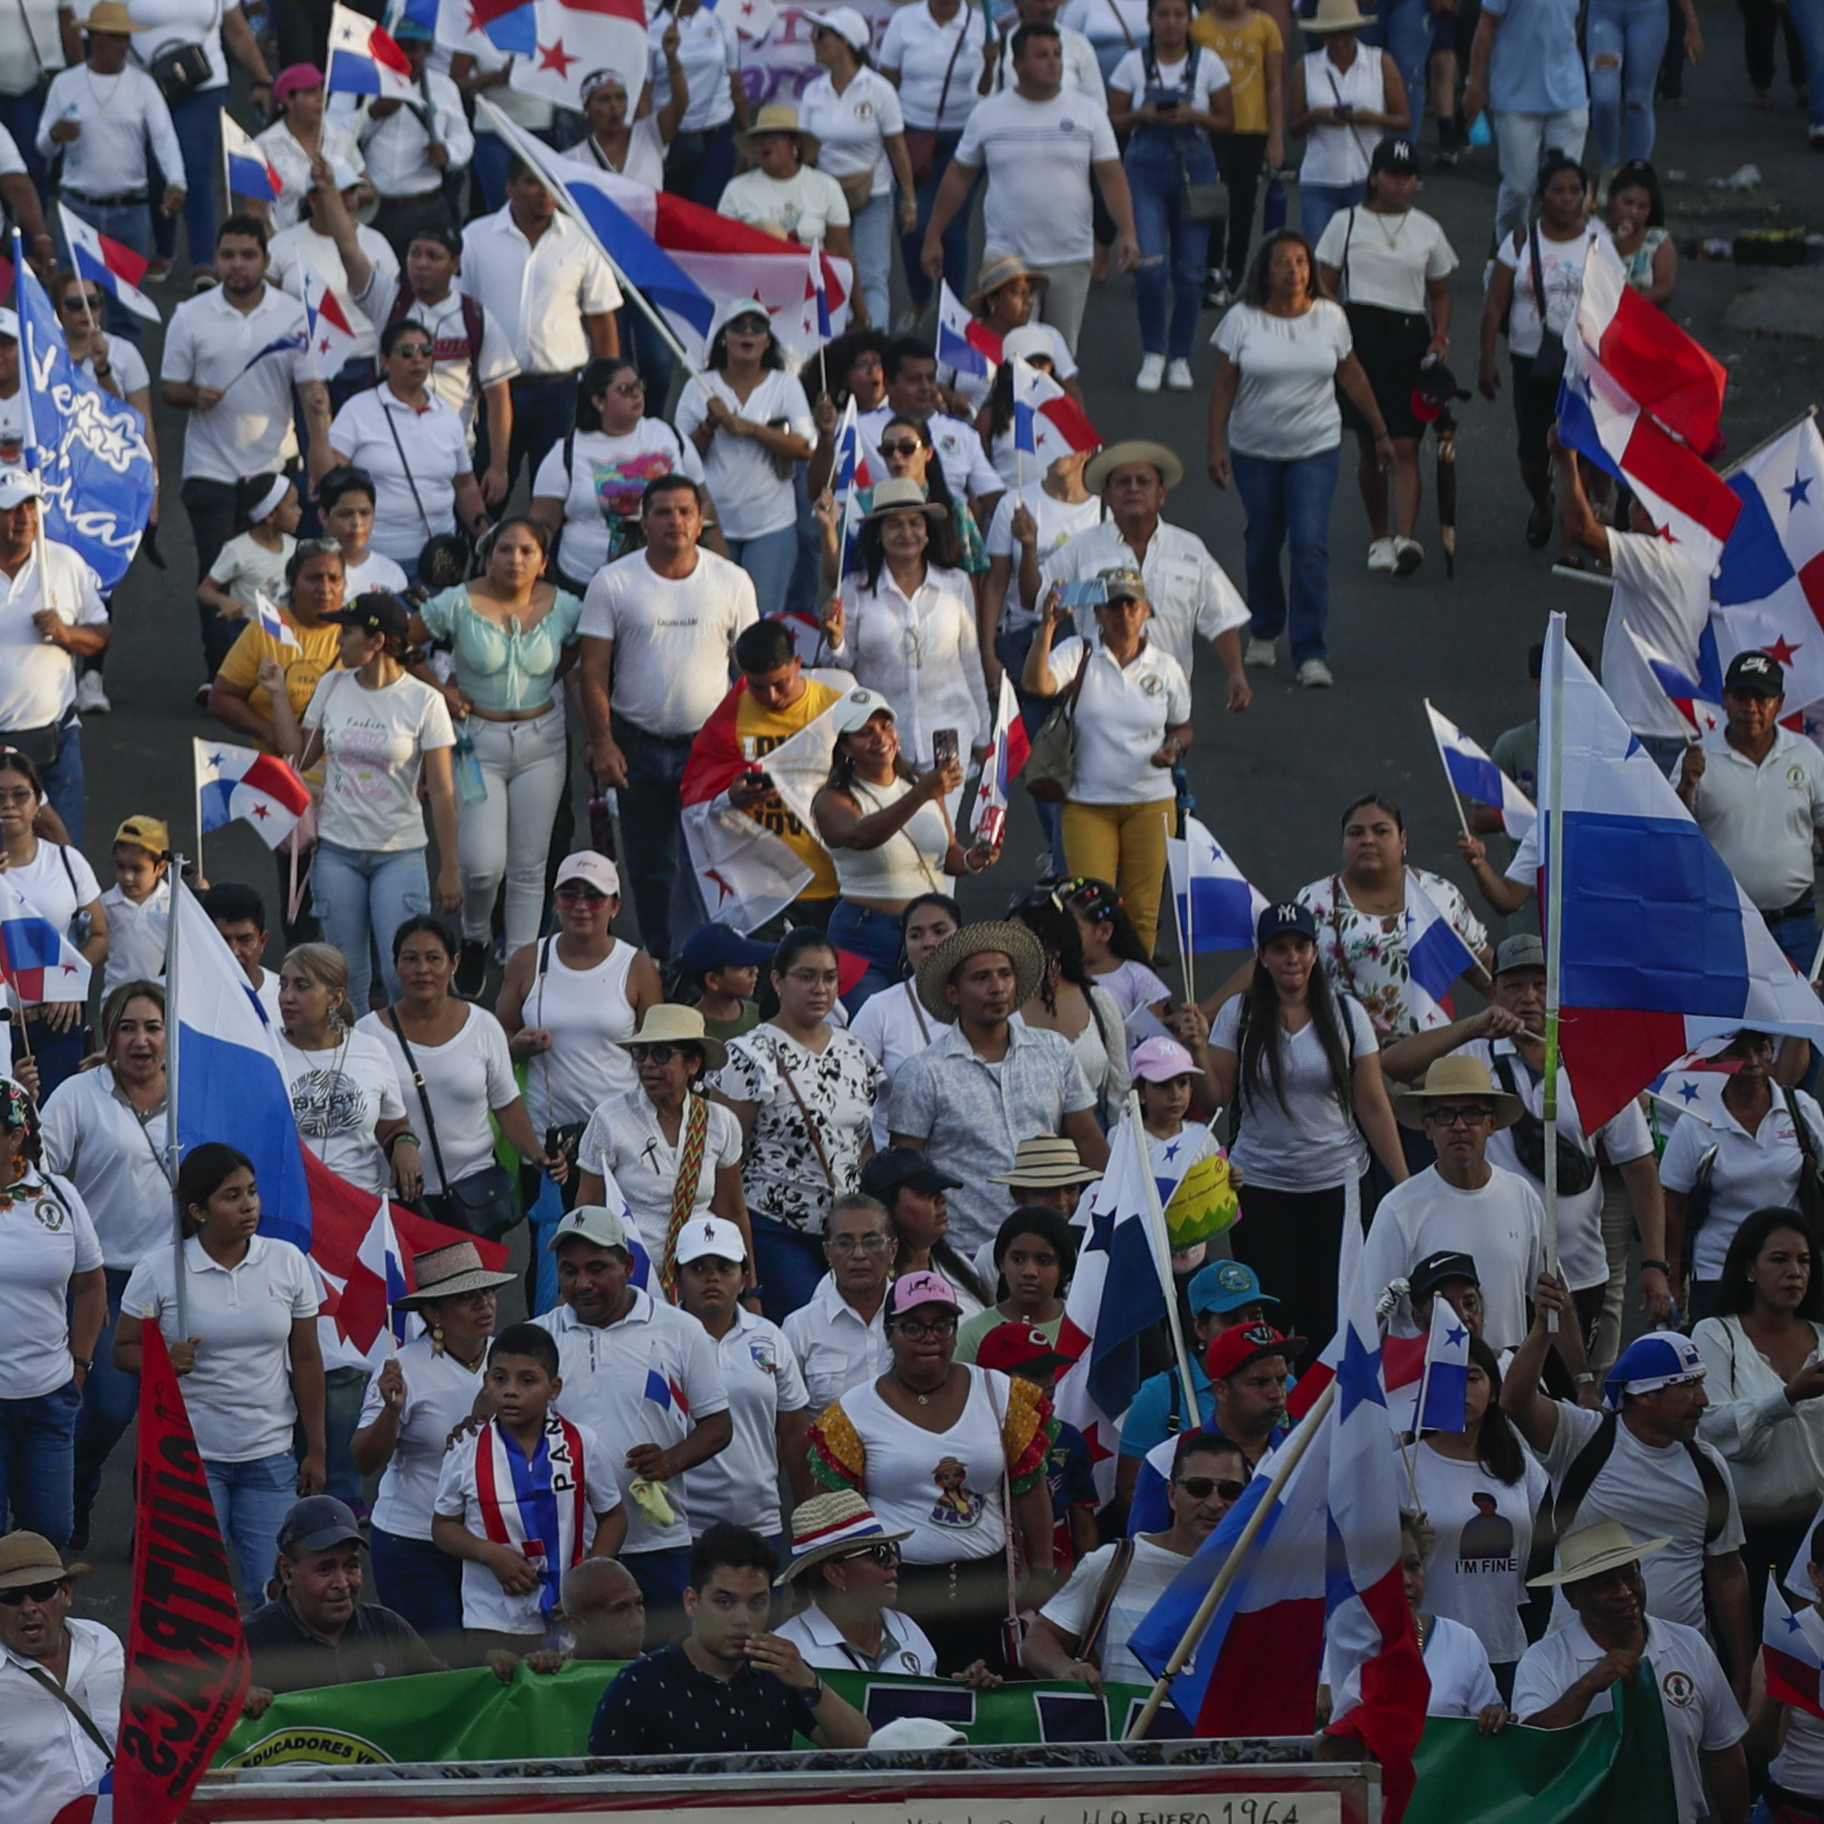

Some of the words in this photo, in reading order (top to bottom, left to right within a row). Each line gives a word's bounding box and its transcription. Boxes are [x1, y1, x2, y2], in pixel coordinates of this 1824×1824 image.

[1455, 1560, 1478, 1575] I'M
[1482, 1558, 1519, 1574] FINE
[240, 1736, 354, 1768] EDUCADORES
